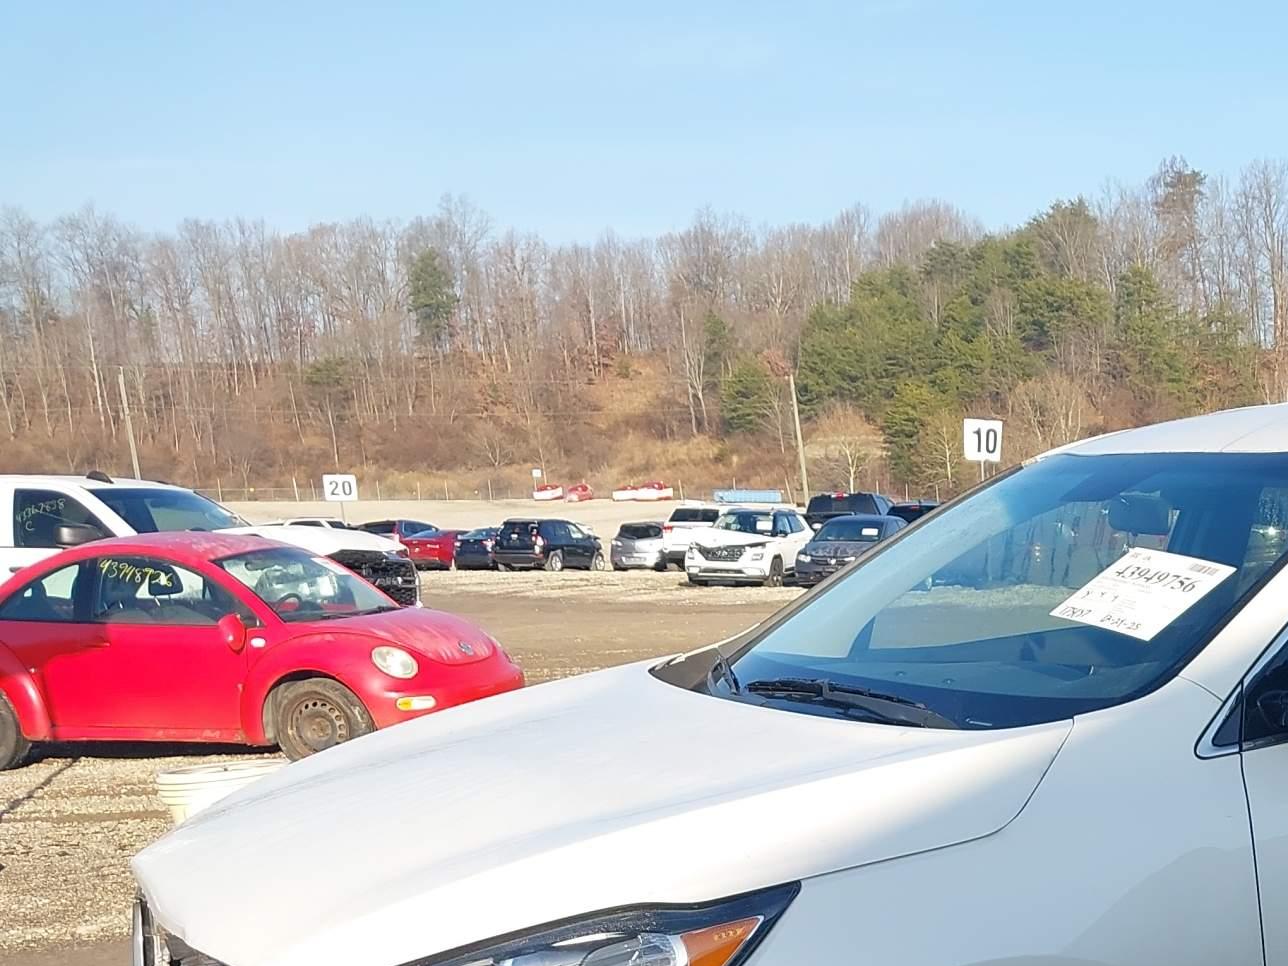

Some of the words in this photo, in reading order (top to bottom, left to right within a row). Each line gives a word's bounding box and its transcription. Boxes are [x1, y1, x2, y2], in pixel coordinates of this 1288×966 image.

[972, 427, 998, 454] 10
[329, 480, 352, 496] 20
[1115, 564, 1200, 593] 43949756
